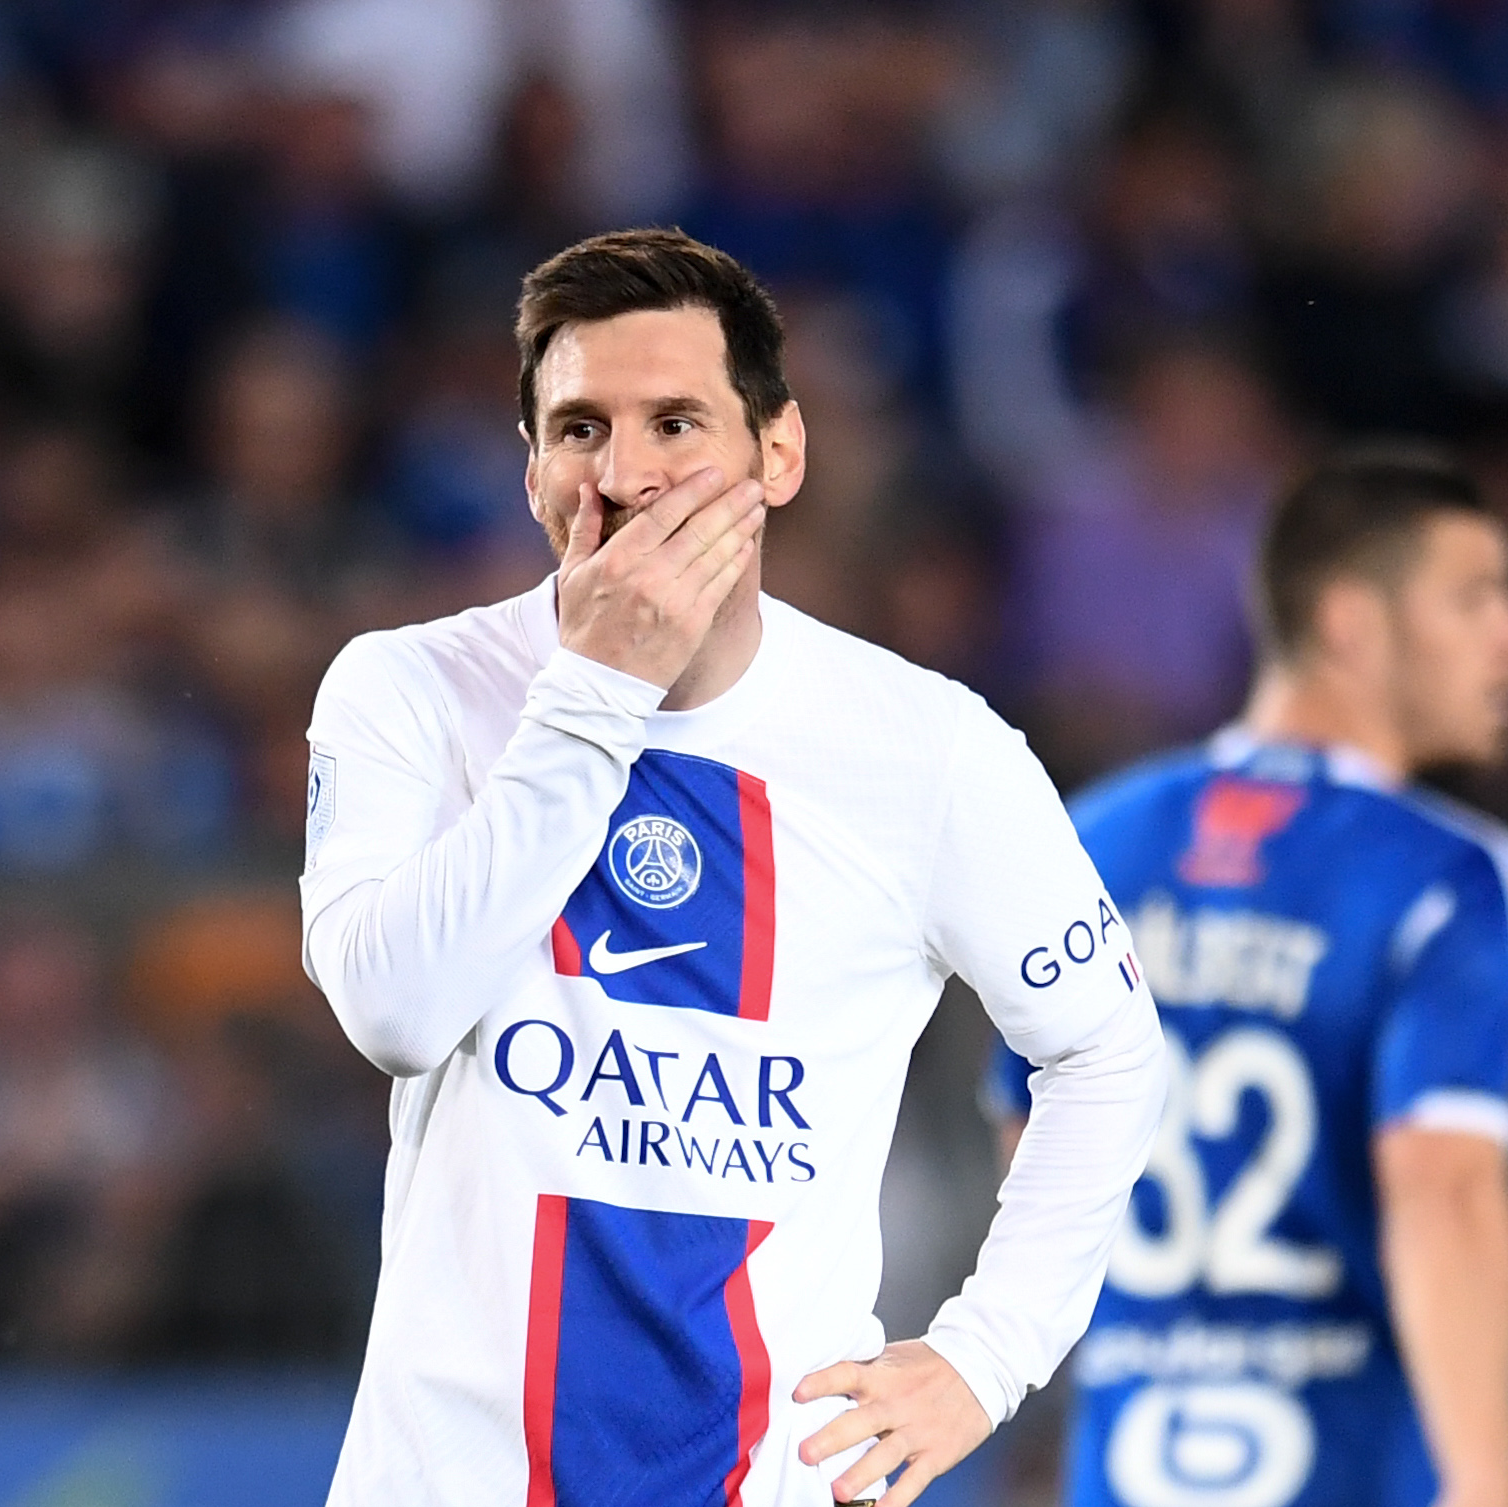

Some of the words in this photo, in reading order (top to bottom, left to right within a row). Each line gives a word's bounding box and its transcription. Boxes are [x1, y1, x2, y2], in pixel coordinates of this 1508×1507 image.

[623, 821, 686, 846] PARIS
[1020, 897, 1120, 990] GOA
[493, 1019, 814, 1131] QATAR
[575, 1115, 817, 1184] AIRWAYS
